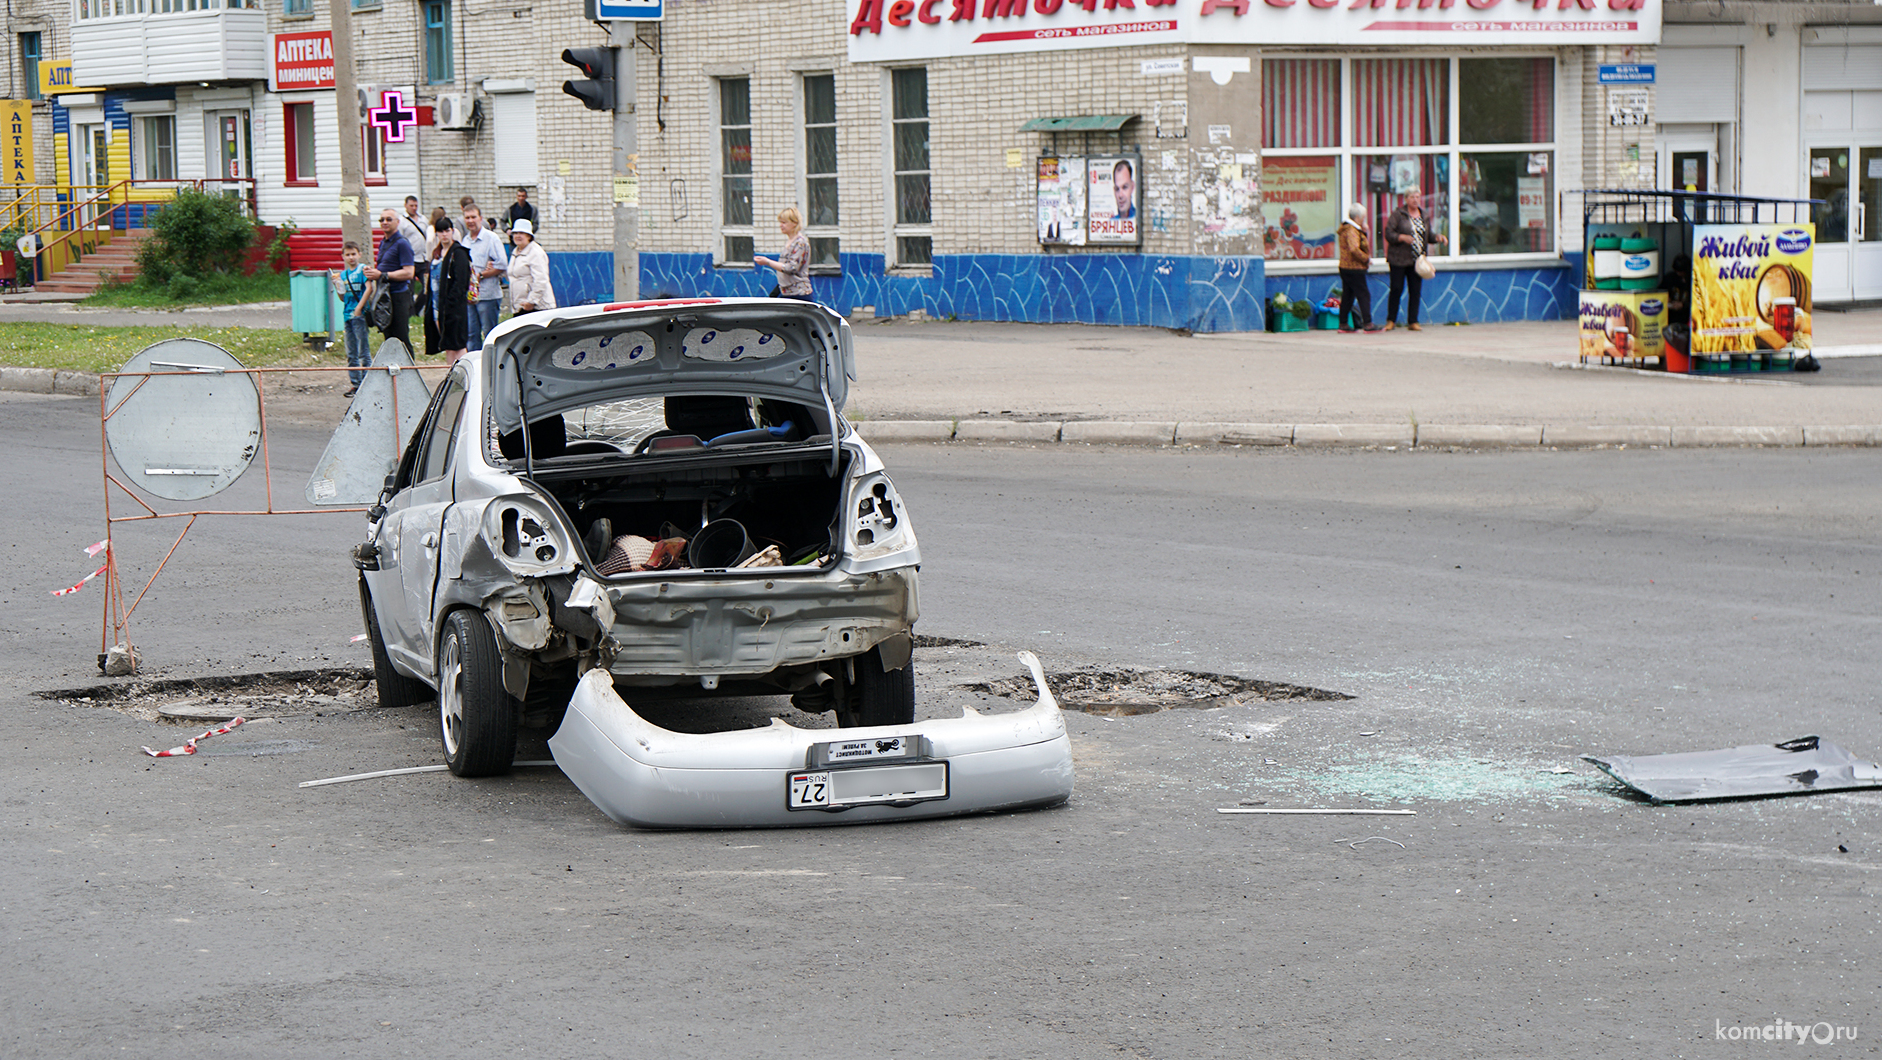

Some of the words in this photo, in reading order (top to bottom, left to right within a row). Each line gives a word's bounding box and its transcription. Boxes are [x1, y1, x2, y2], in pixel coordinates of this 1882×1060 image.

[850, 0, 1177, 35] Десято
[1451, 22, 1503, 31] сеть
[1510, 22, 1629, 31] магазинов
[1035, 29, 1072, 38] сеть
[1076, 21, 1170, 37] магазинов
[278, 37, 333, 62] АПТЕКА
[11, 112, 25, 181] АПТЕКА
[1091, 221, 1135, 235] БРЯНЦЕВ
[1699, 234, 1771, 259] Живой
[1718, 260, 1760, 280] квас
[1579, 302, 1622, 318] Живой
[808, 775, 827, 783] RUS
[801, 784, 825, 804] 27
